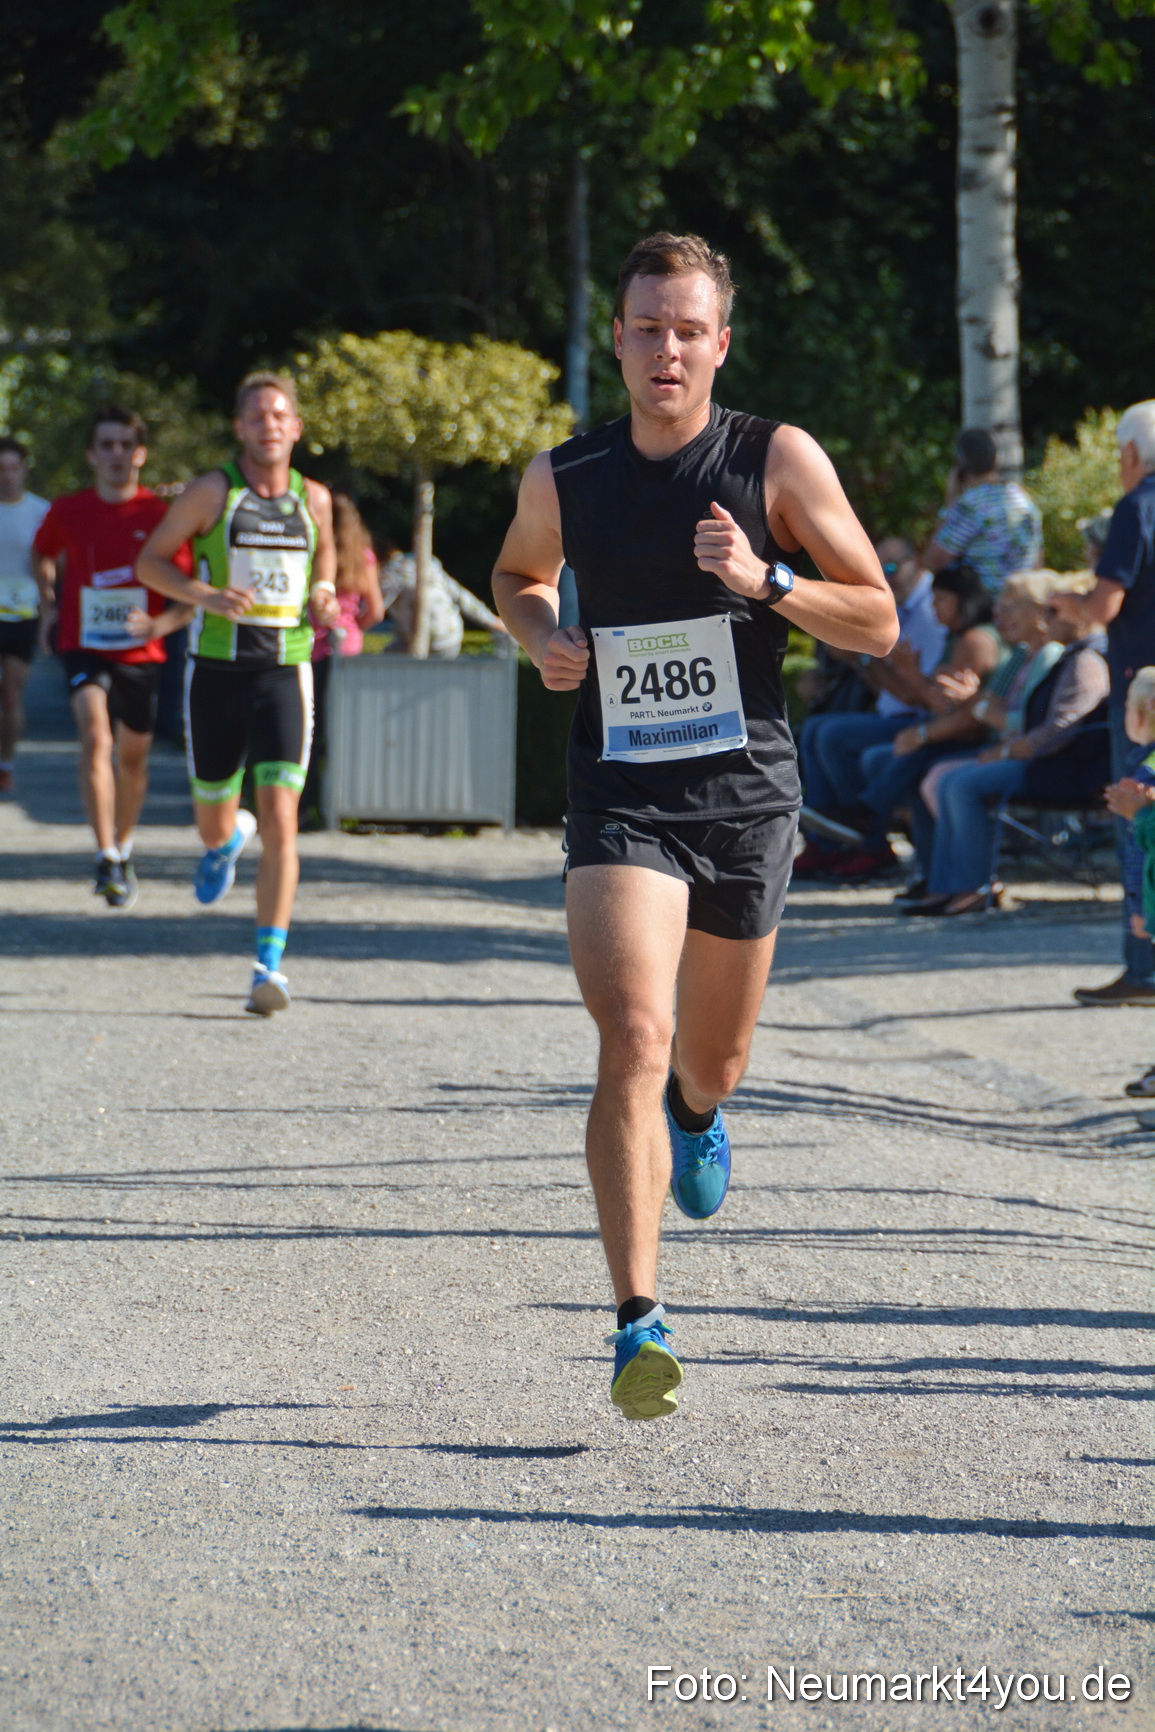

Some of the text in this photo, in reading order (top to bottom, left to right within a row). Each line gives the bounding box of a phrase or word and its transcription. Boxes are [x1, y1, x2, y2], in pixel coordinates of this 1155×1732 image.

[249, 570, 290, 595] 243
[627, 633, 690, 653] BOCK
[616, 656, 716, 704] 2486
[629, 706, 700, 719] PARTL Neumarkt
[628, 723, 719, 747] Maximilian
